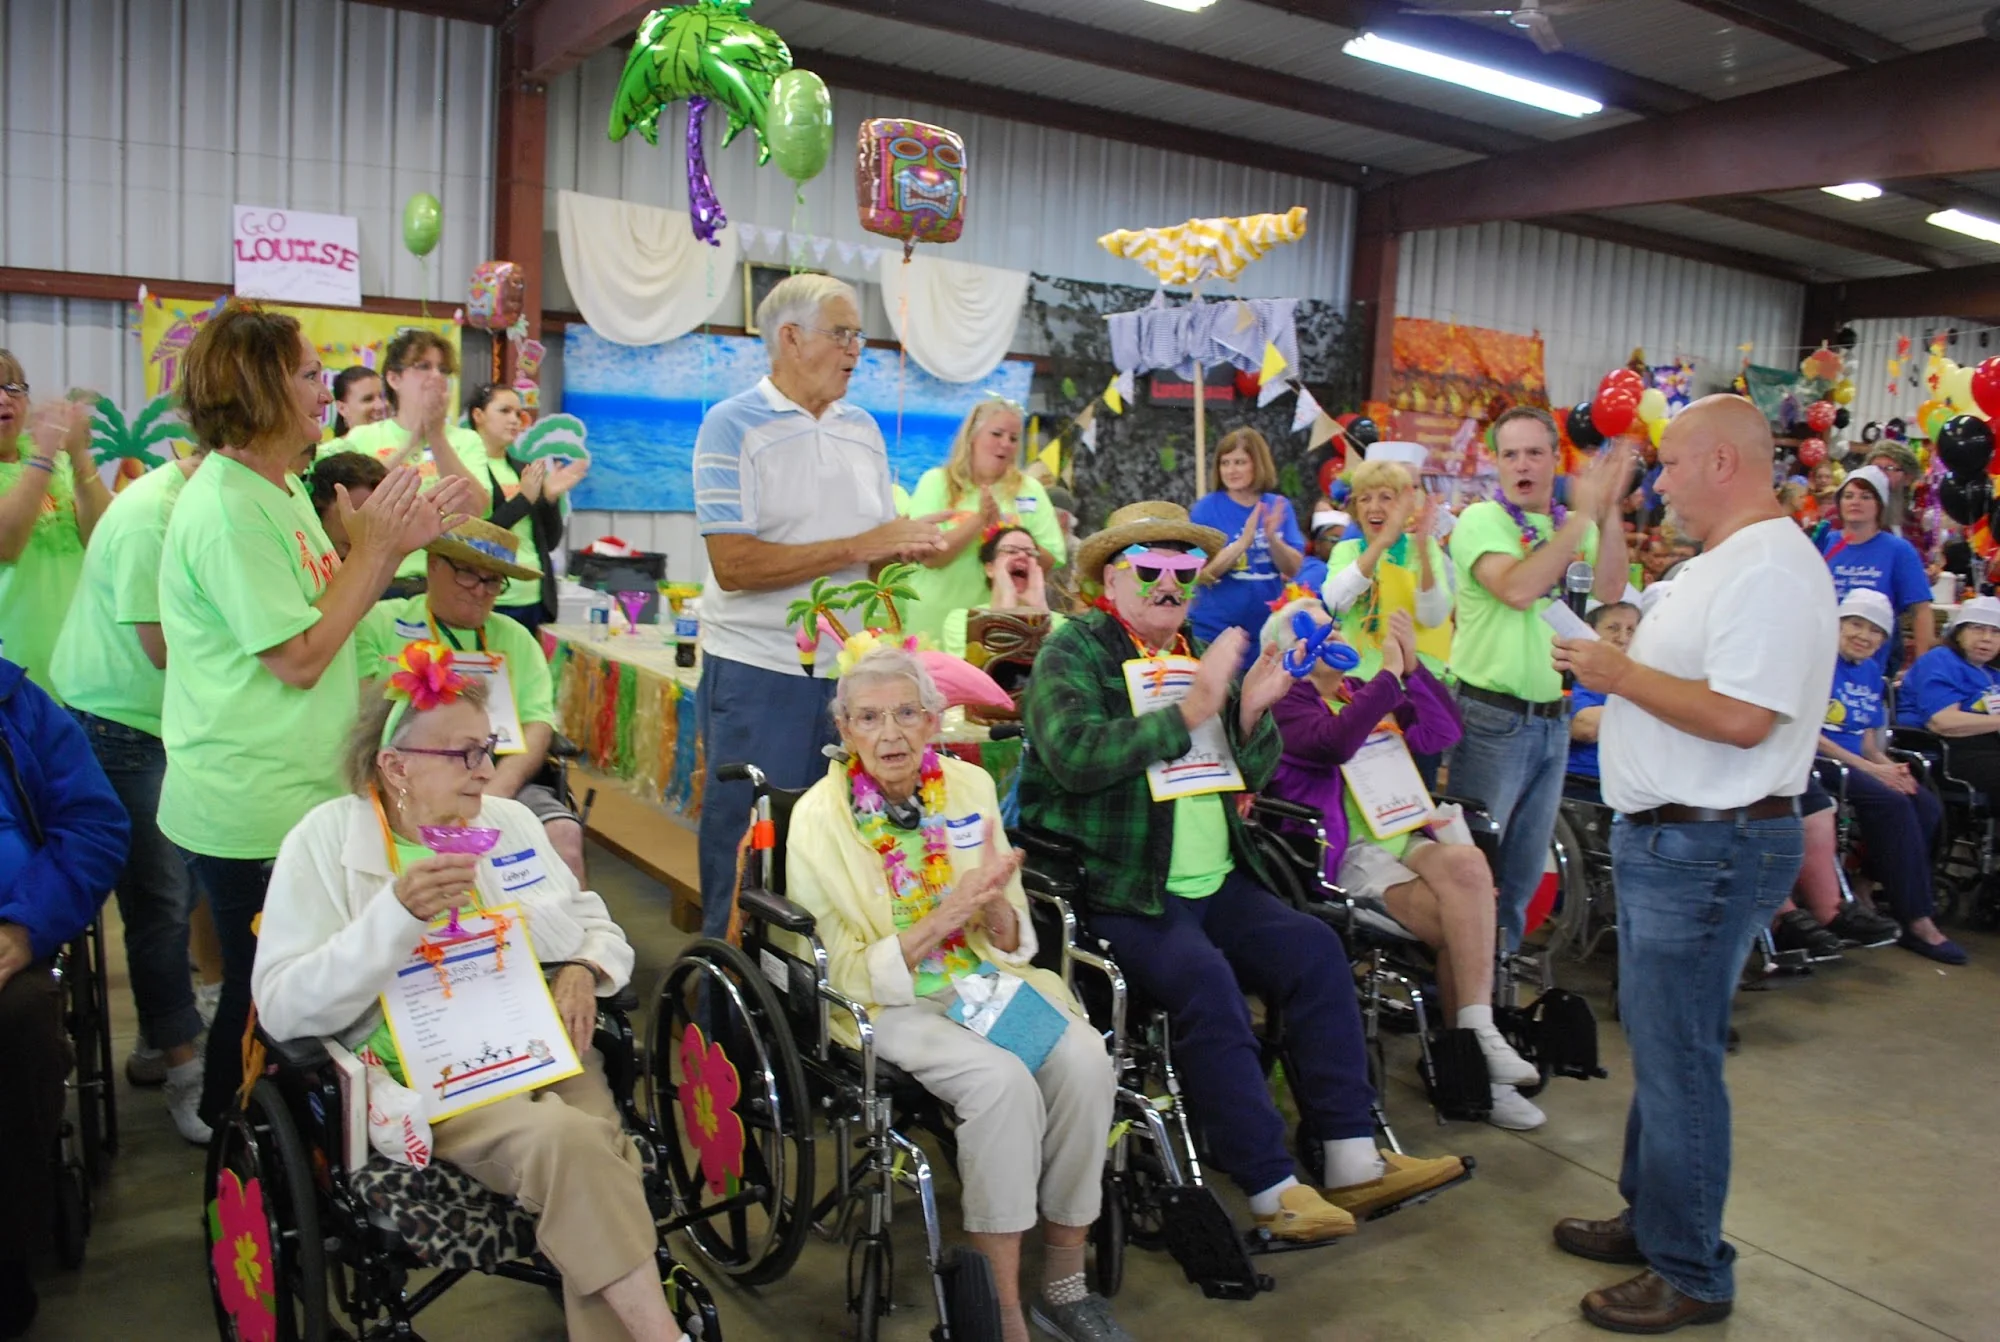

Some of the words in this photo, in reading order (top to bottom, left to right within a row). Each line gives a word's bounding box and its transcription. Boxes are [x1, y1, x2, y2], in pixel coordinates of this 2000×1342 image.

[240, 212, 287, 236] GO
[234, 237, 360, 272] LOUISE
[432, 959, 479, 983] MFORD
